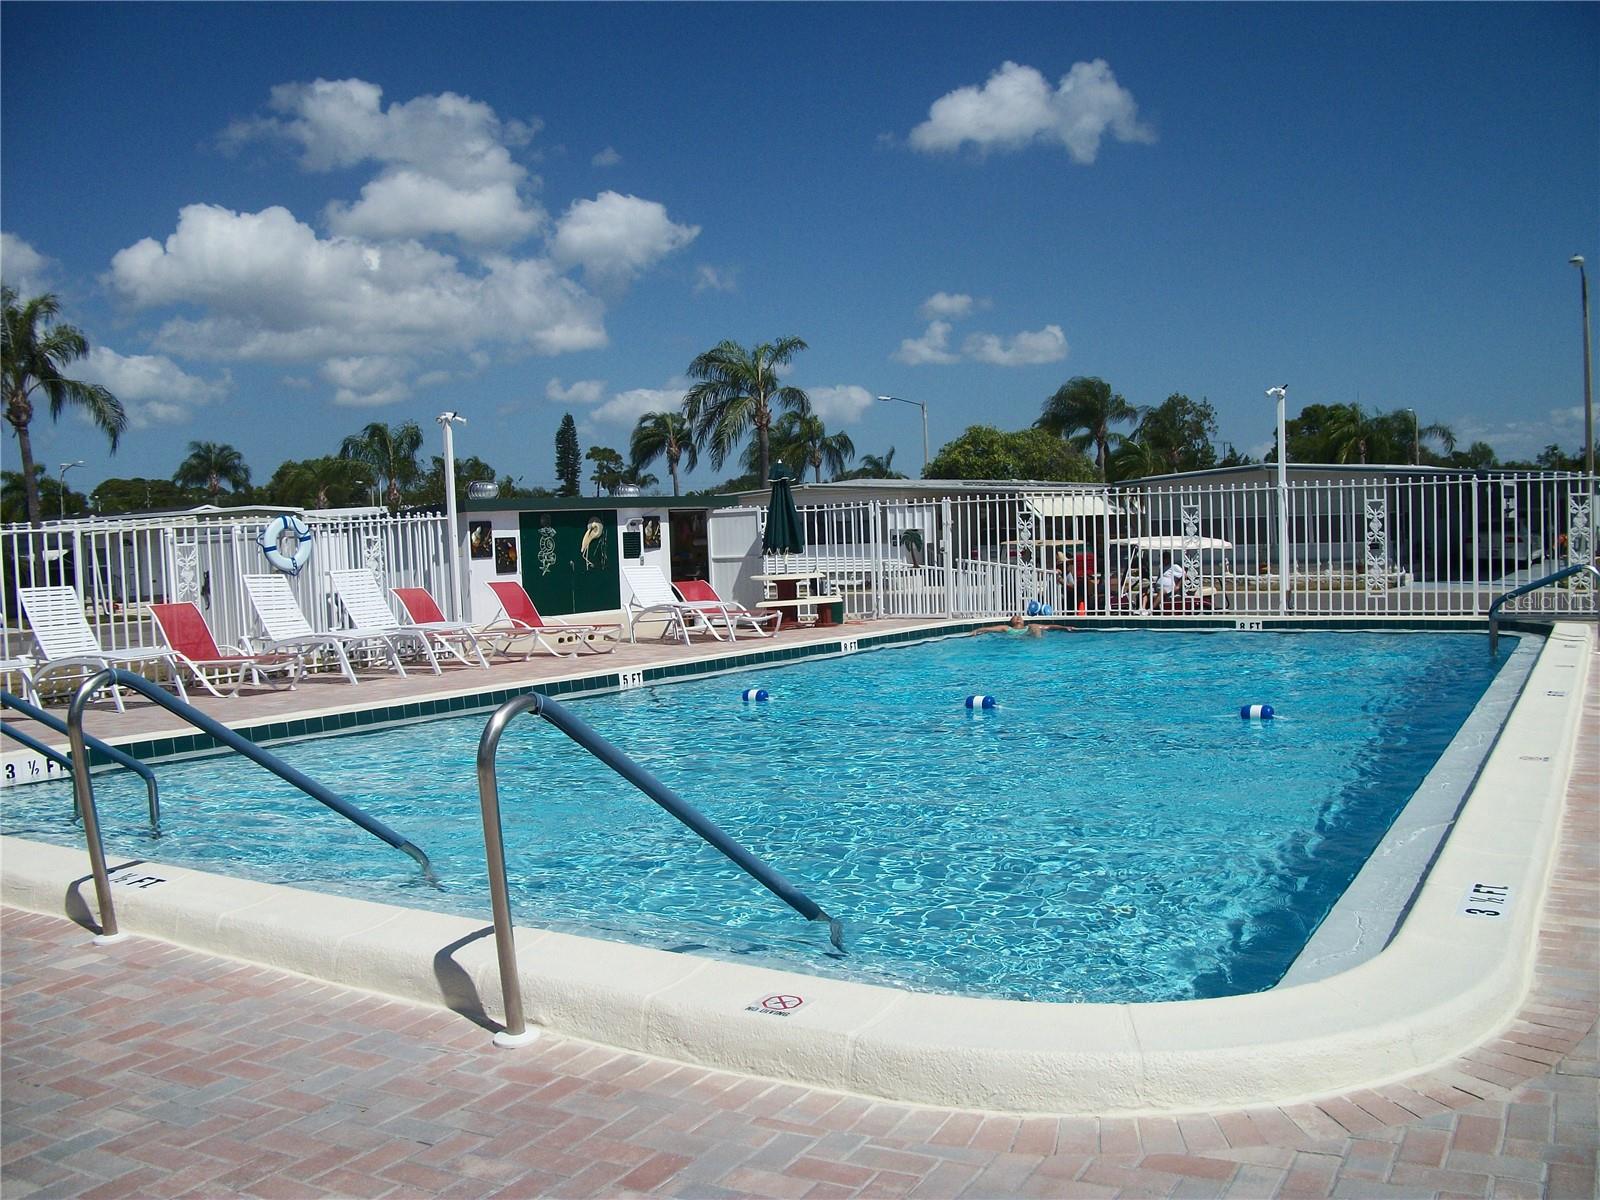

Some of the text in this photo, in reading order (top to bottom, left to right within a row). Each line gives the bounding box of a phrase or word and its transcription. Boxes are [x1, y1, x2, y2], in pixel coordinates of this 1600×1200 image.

[1250, 622, 1260, 630] FT
[623, 672, 641, 685] 5 FT
[5, 763, 16, 779] 3
[1473, 883, 1509, 896] FT
[1465, 908, 1501, 917] 3
[759, 1008, 791, 1017] DIVING
